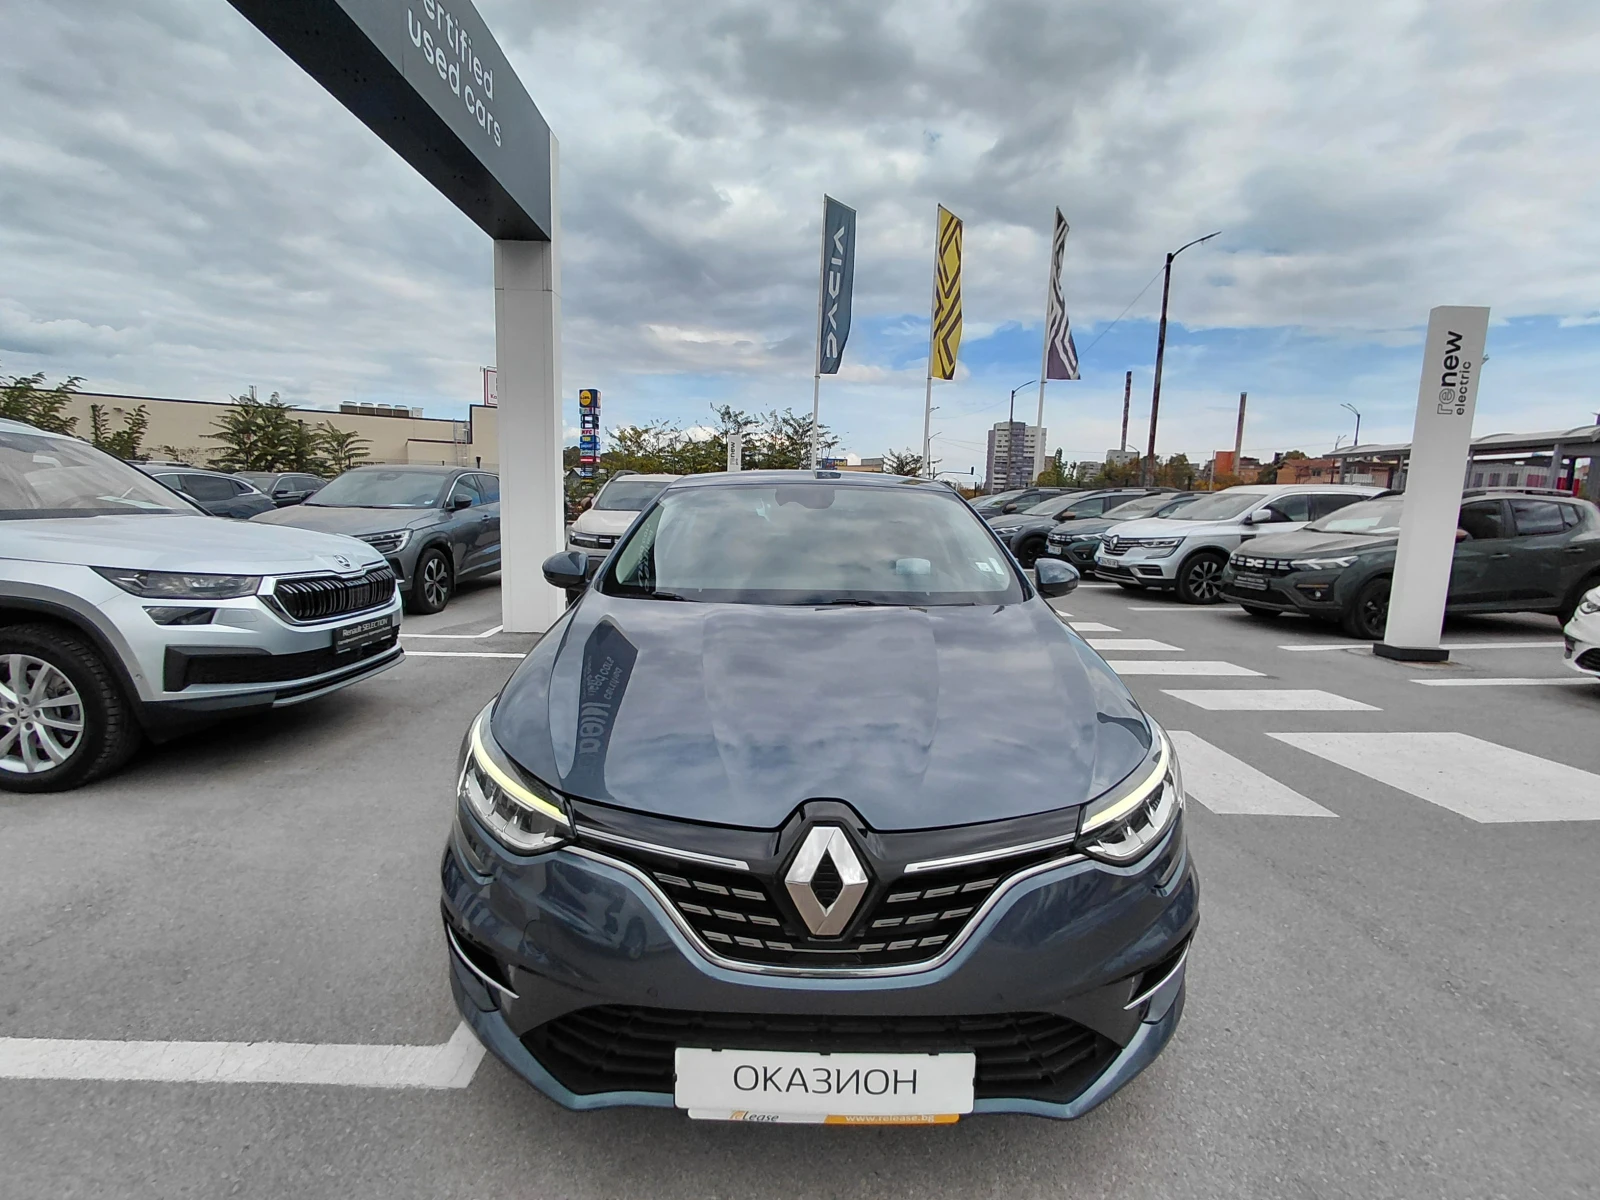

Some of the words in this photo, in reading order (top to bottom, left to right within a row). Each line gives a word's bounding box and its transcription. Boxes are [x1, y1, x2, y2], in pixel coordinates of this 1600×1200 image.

[408, 8, 460, 97] used
[464, 85, 501, 147] cars
[423, 0, 493, 101] ertified
[826, 226, 845, 358] DACIA
[1437, 331, 1463, 415] renew
[1455, 361, 1471, 415] electric
[343, 626, 362, 636] Renault
[362, 618, 388, 631] SELECTION
[733, 1064, 918, 1095] ОКАЗИОН
[845, 1114, 935, 1123] www.release.bg
